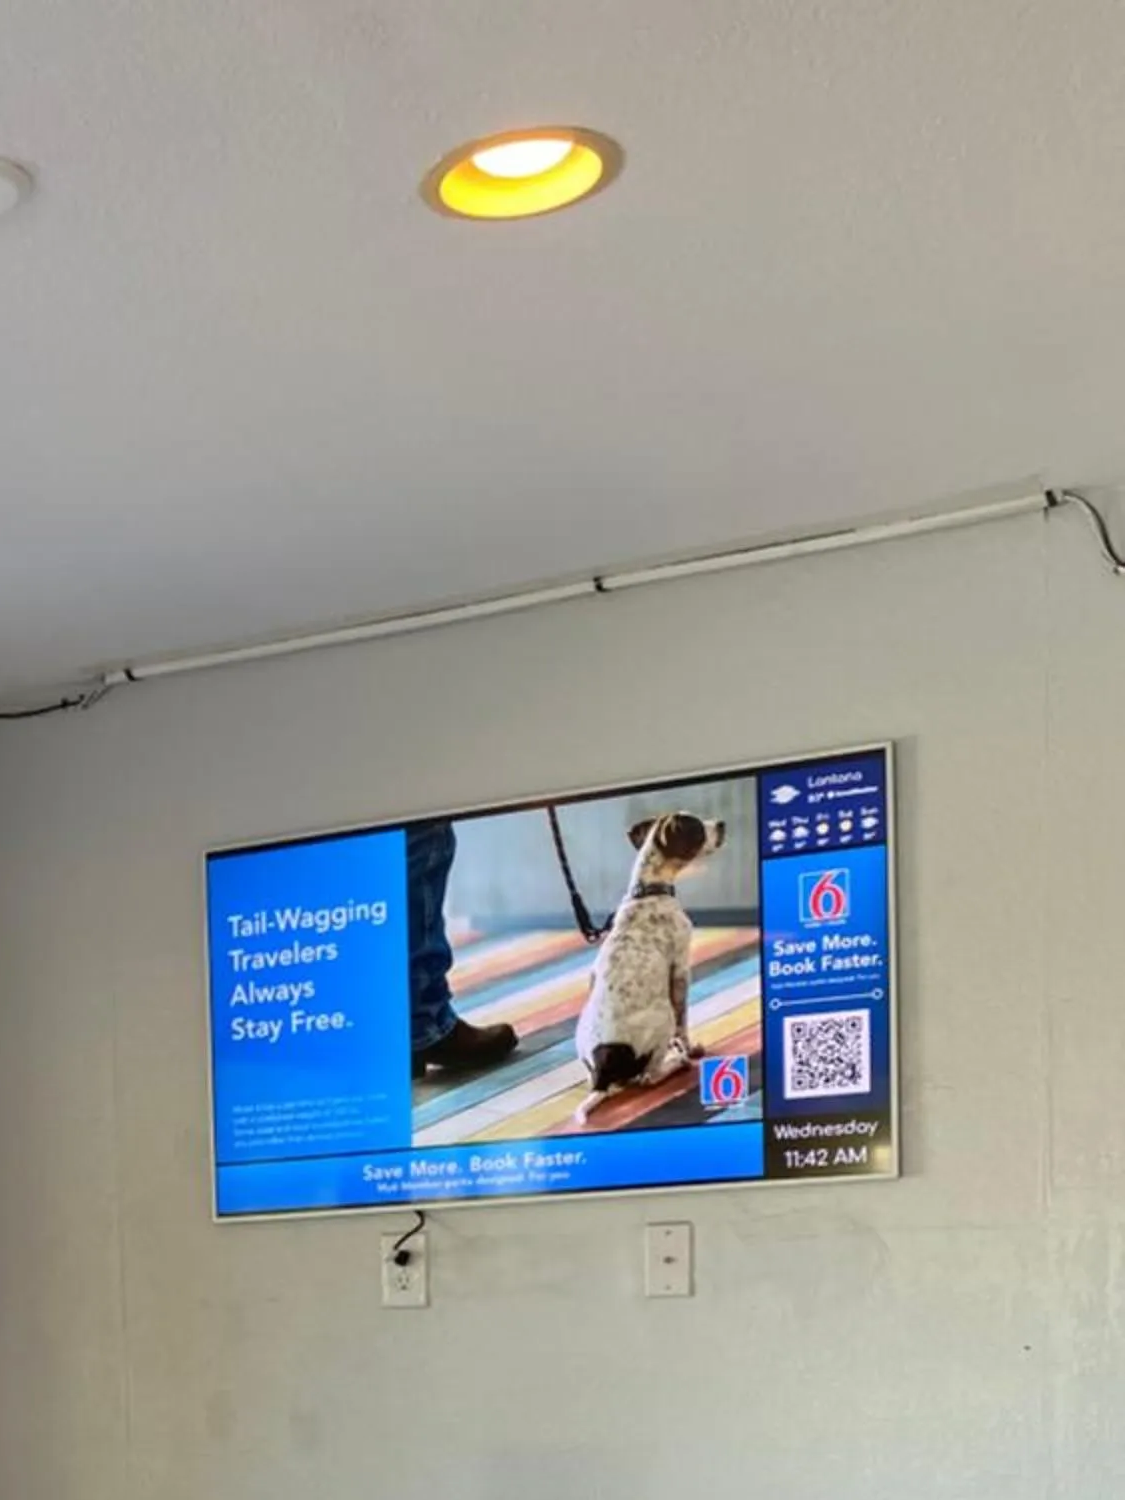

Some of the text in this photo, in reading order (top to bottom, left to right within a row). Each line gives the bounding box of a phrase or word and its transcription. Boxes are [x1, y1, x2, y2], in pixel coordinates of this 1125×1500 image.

[808, 868, 846, 921] 6
[227, 898, 388, 938] Tail-Wagging
[227, 940, 338, 973] Travelers
[773, 934, 877, 957] Save More.
[769, 953, 883, 977] Book Faster.
[230, 981, 315, 1007] Always
[231, 1009, 354, 1043] Stay Free.
[711, 1055, 743, 1106] 6
[773, 1119, 879, 1140] Wednesday
[362, 1151, 587, 1181] Save More. Book Faster.
[783, 1145, 867, 1168] 11:42 AM
